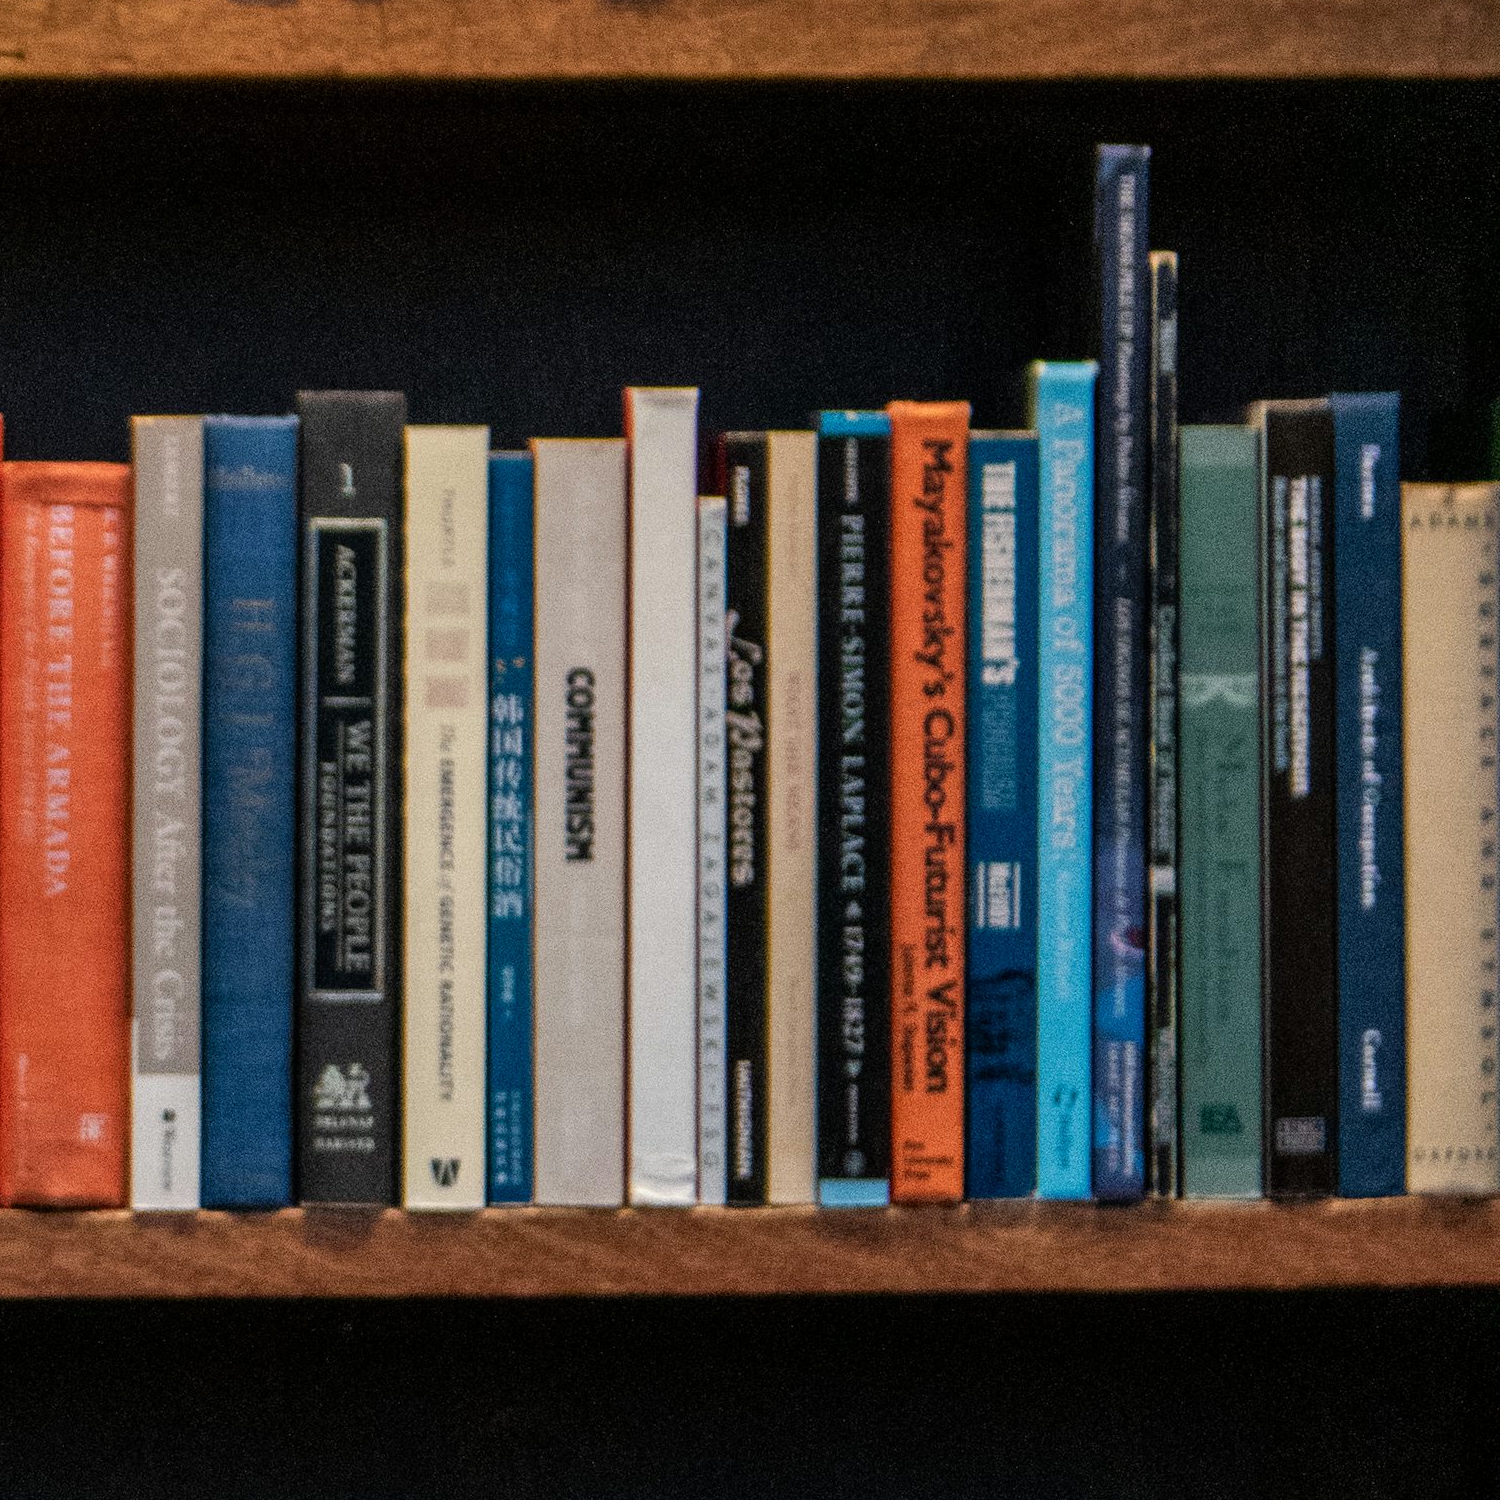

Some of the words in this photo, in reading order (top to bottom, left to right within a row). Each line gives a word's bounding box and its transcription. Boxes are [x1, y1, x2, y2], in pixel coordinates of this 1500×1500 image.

[46, 504, 74, 639] BEFORE
[914, 439, 956, 696] Mayakovsky's
[1053, 438, 1083, 607] Panorama
[336, 545, 357, 681] ACKERMAN
[842, 515, 865, 742] PIERRE-SIMON
[1053, 616, 1083, 652] of
[46, 655, 74, 726] THE
[154, 567, 188, 798] SOCIOLOGY
[346, 722, 371, 770] WE
[1053, 663, 1083, 746] 5000
[44, 742, 72, 898] ARMADA
[346, 783, 371, 843] THE
[439, 759, 455, 870] EMERGENCE
[566, 668, 596, 862] COMMUNISM
[725, 711, 763, 885] Pastores
[842, 755, 865, 891] LAPLACE
[154, 811, 188, 900] After
[320, 760, 336, 931] FOUNDATIONS
[923, 709, 956, 969] Cubo-Futurist
[154, 906, 188, 960] the
[346, 855, 371, 970] PEOPLE
[154, 969, 188, 1061] Crisis
[923, 980, 956, 1094] Vision
